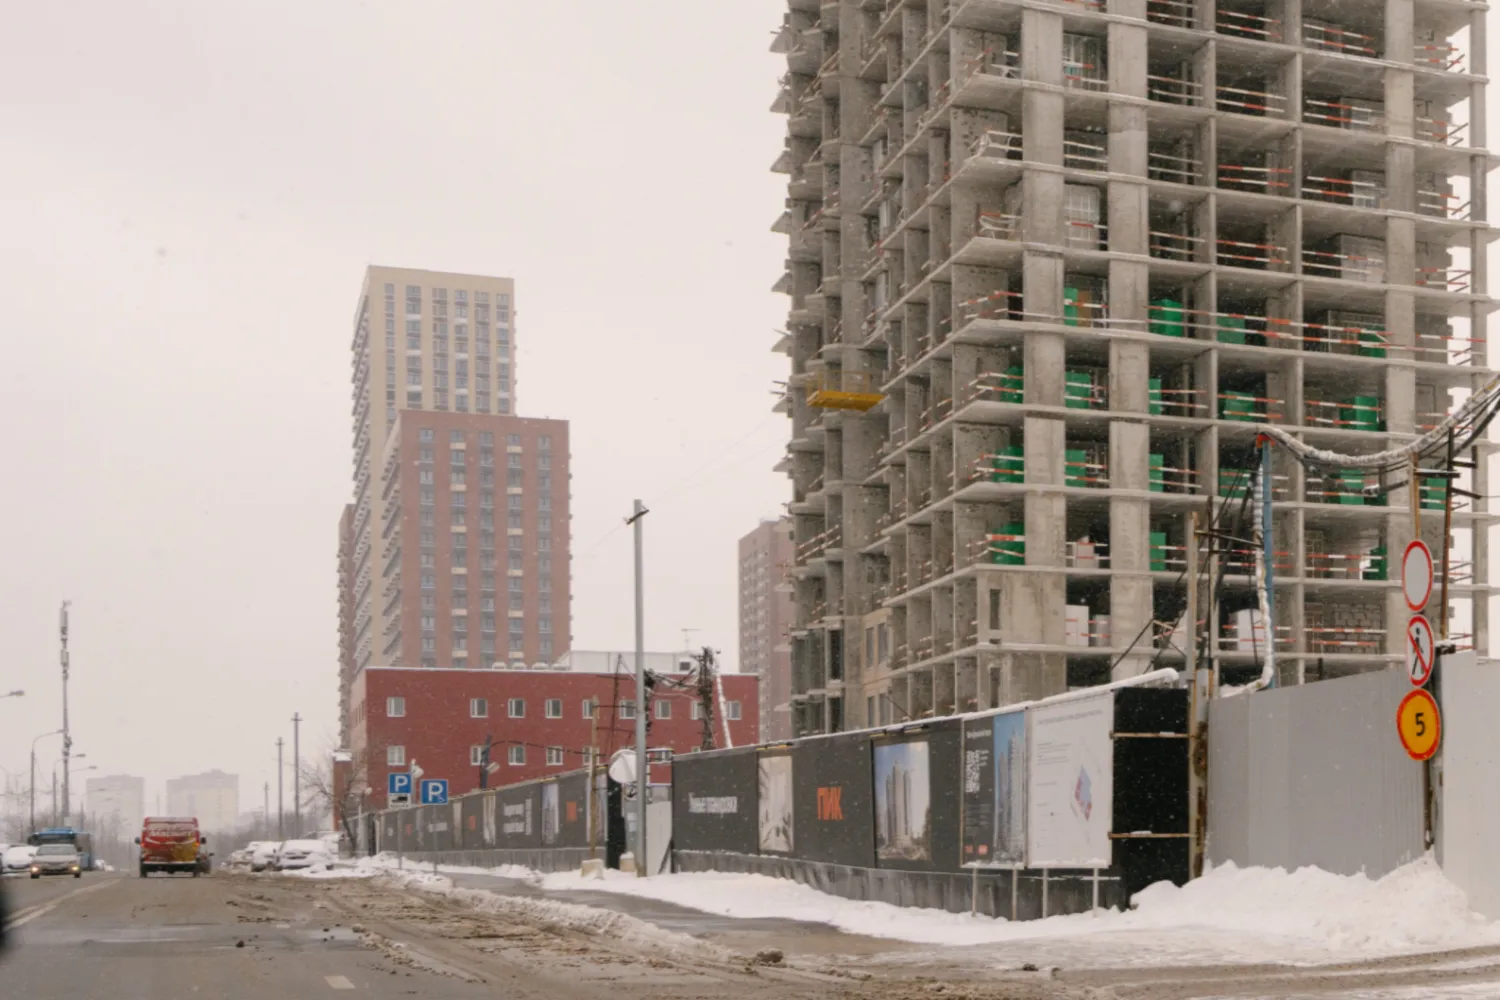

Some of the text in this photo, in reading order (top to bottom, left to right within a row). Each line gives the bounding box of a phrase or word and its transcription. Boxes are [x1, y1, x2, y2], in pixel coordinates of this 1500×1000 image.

[1415, 712, 1425, 737] 5
[395, 775, 408, 792] P
[428, 782, 444, 802] P
[817, 787, 844, 820] ПИК
